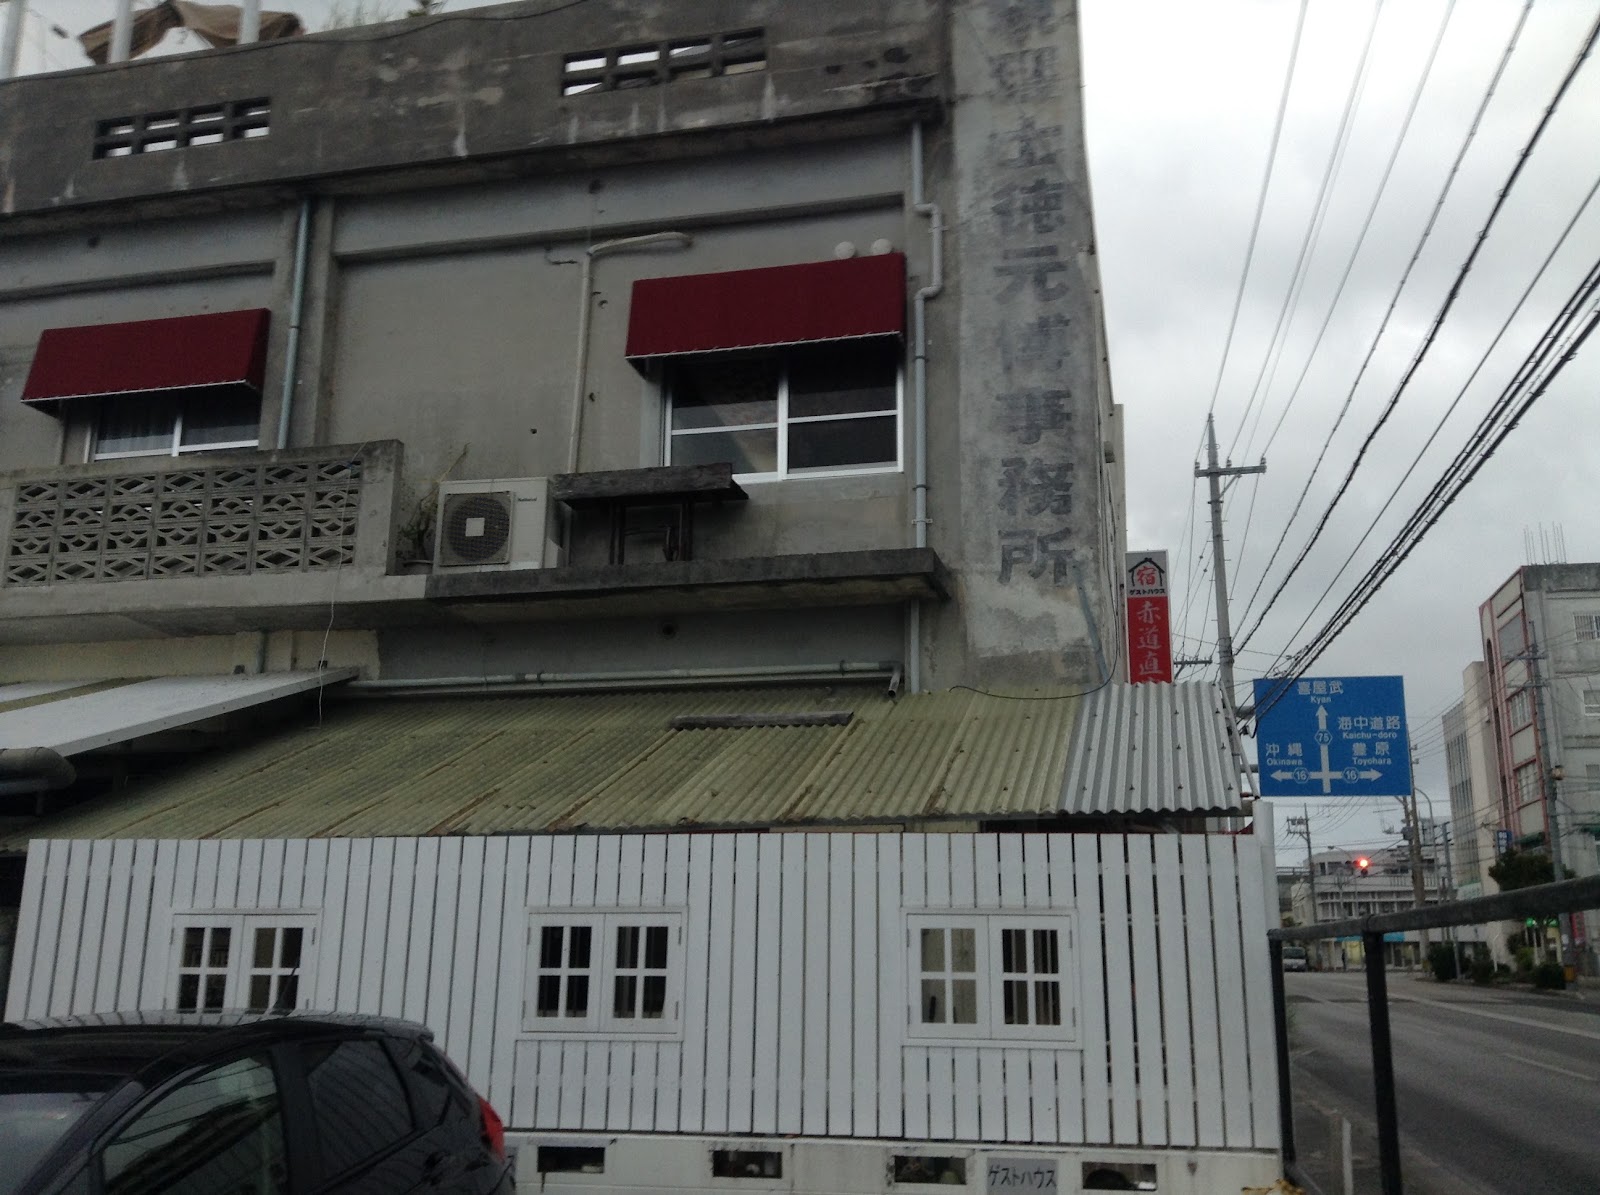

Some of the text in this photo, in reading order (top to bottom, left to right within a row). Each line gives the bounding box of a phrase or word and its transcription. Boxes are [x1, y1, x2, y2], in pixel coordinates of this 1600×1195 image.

[1136, 565, 1157, 586] 宿
[1129, 588, 1166, 596] ゲストハウス
[1137, 600, 1163, 684] 赤道直
[1298, 681, 1343, 694] 喜屋武
[1310, 695, 1331, 704] Kyan
[1338, 716, 1401, 730] 海中道路
[1342, 731, 1397, 740] Kaichu-doro
[1266, 742, 1303, 757] 沖縄
[1352, 741, 1390, 756] 豊原
[1267, 757, 1303, 766] Okinawa
[1352, 756, 1392, 767] Toyohara
[1296, 770, 1307, 781] 16
[1345, 770, 1357, 781] 16
[988, 1164, 1057, 1189] ゲストハウス
